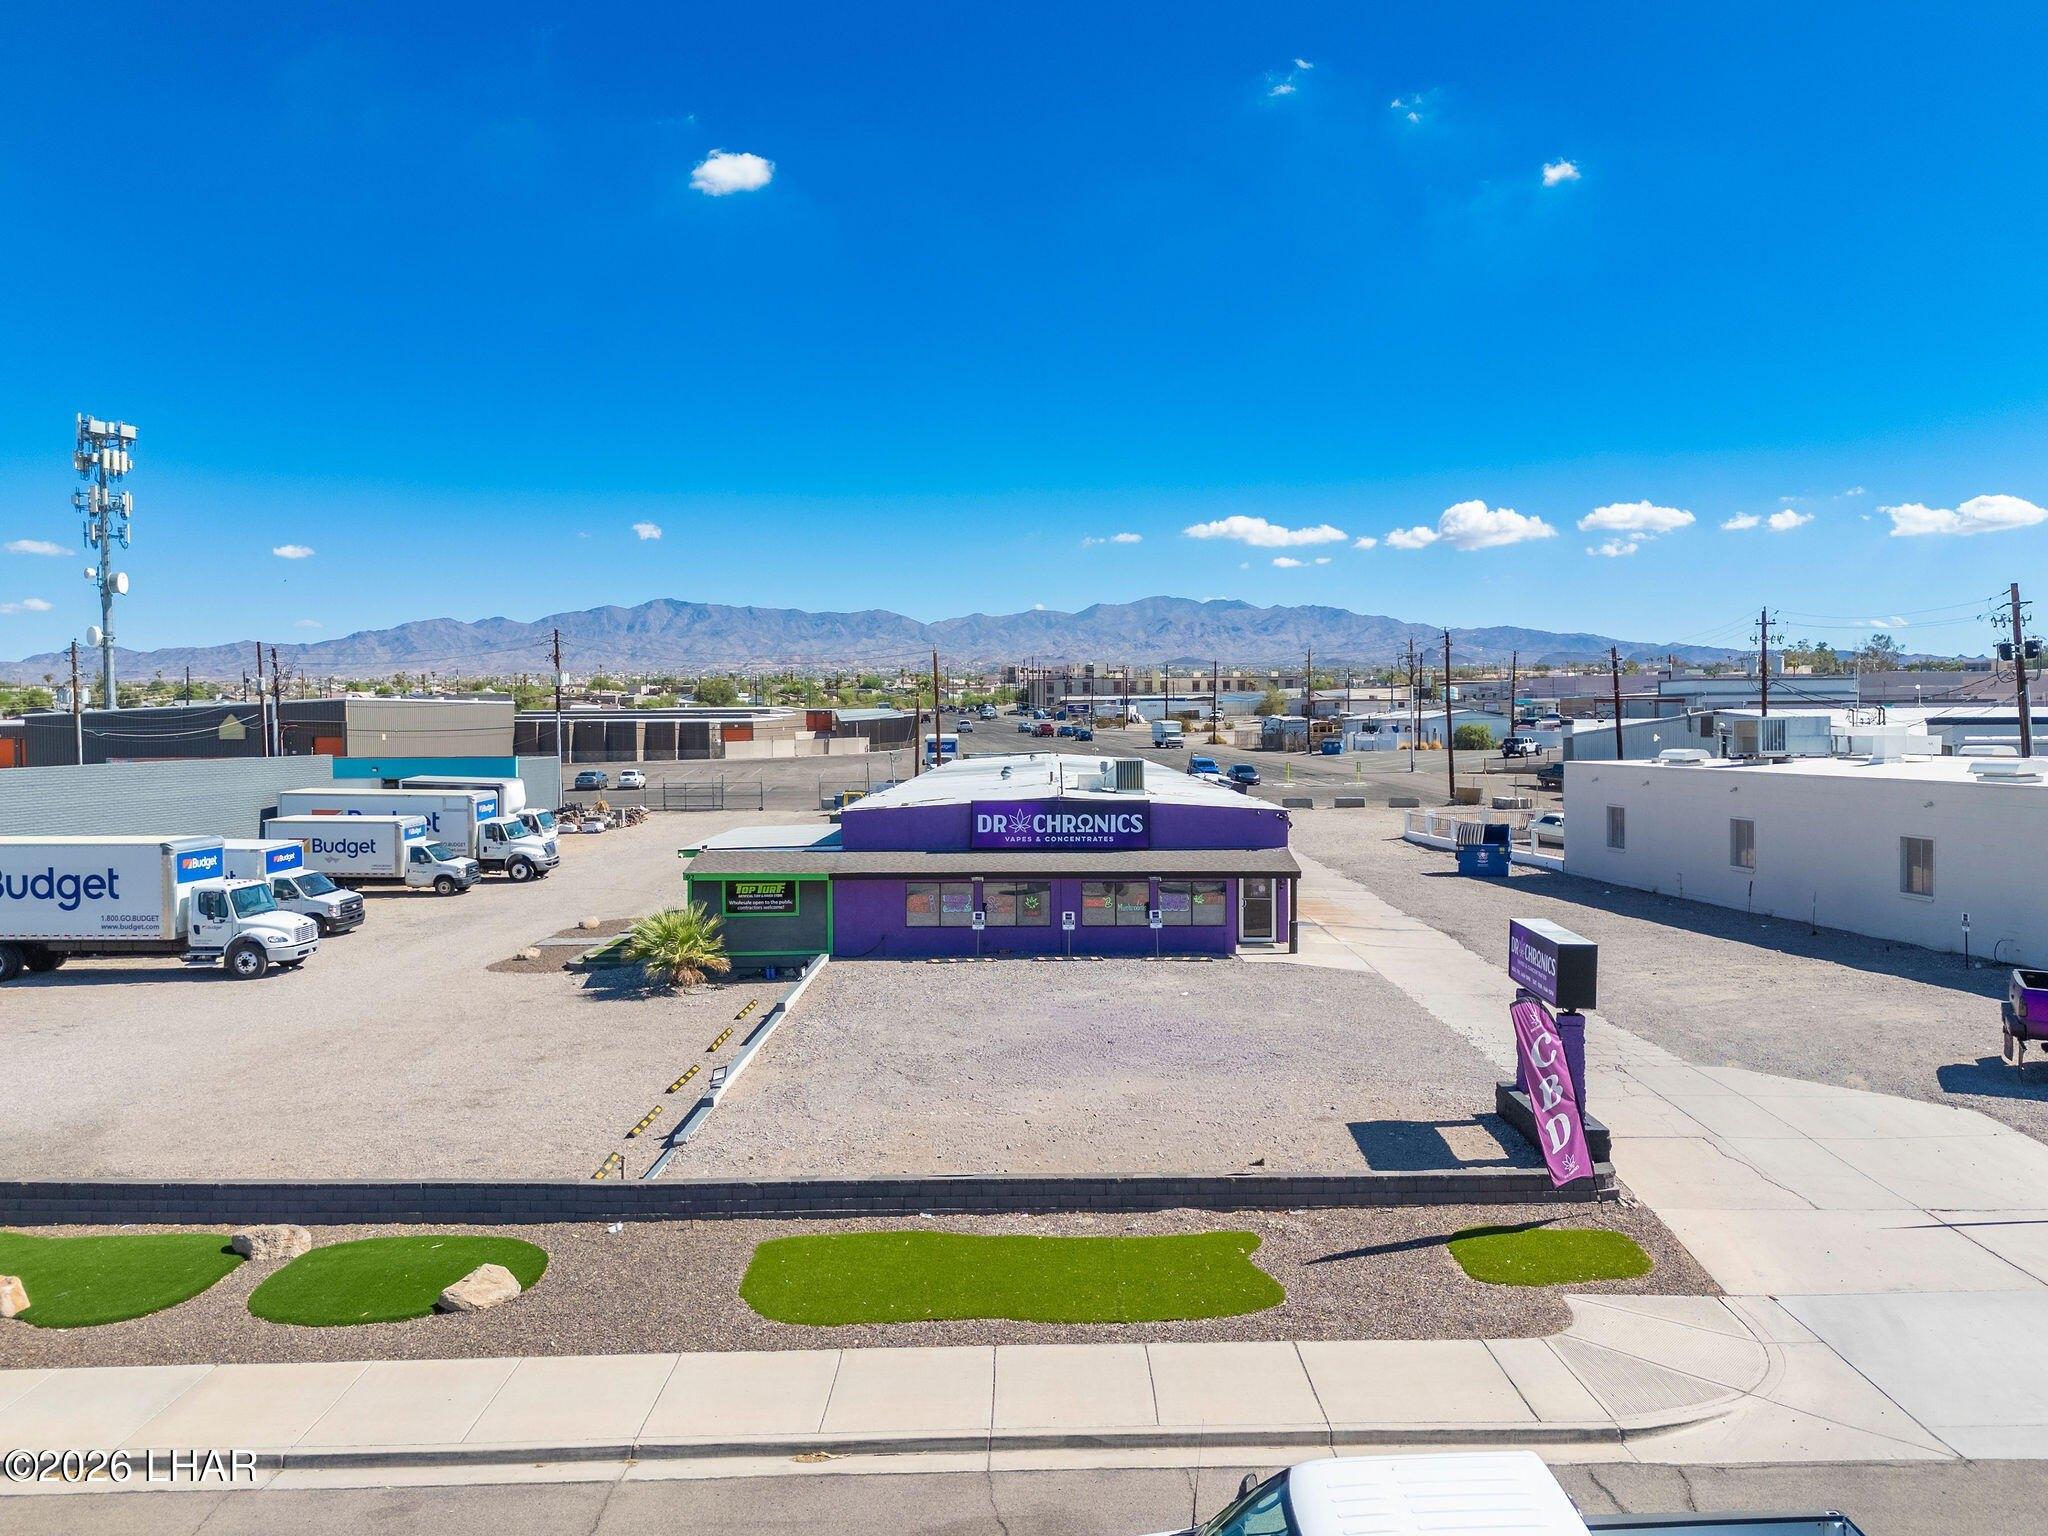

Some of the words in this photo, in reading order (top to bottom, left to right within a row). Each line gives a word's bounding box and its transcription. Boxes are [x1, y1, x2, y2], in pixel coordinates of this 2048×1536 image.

[977, 814, 1007, 833] DR
[312, 838, 376, 858] Budget
[191, 856, 218, 870] Budget
[279, 852, 296, 862] Budget
[736, 883, 756, 894] TOP
[101, 923, 160, 931] www.budget.com
[1511, 936, 1519, 956] DR
